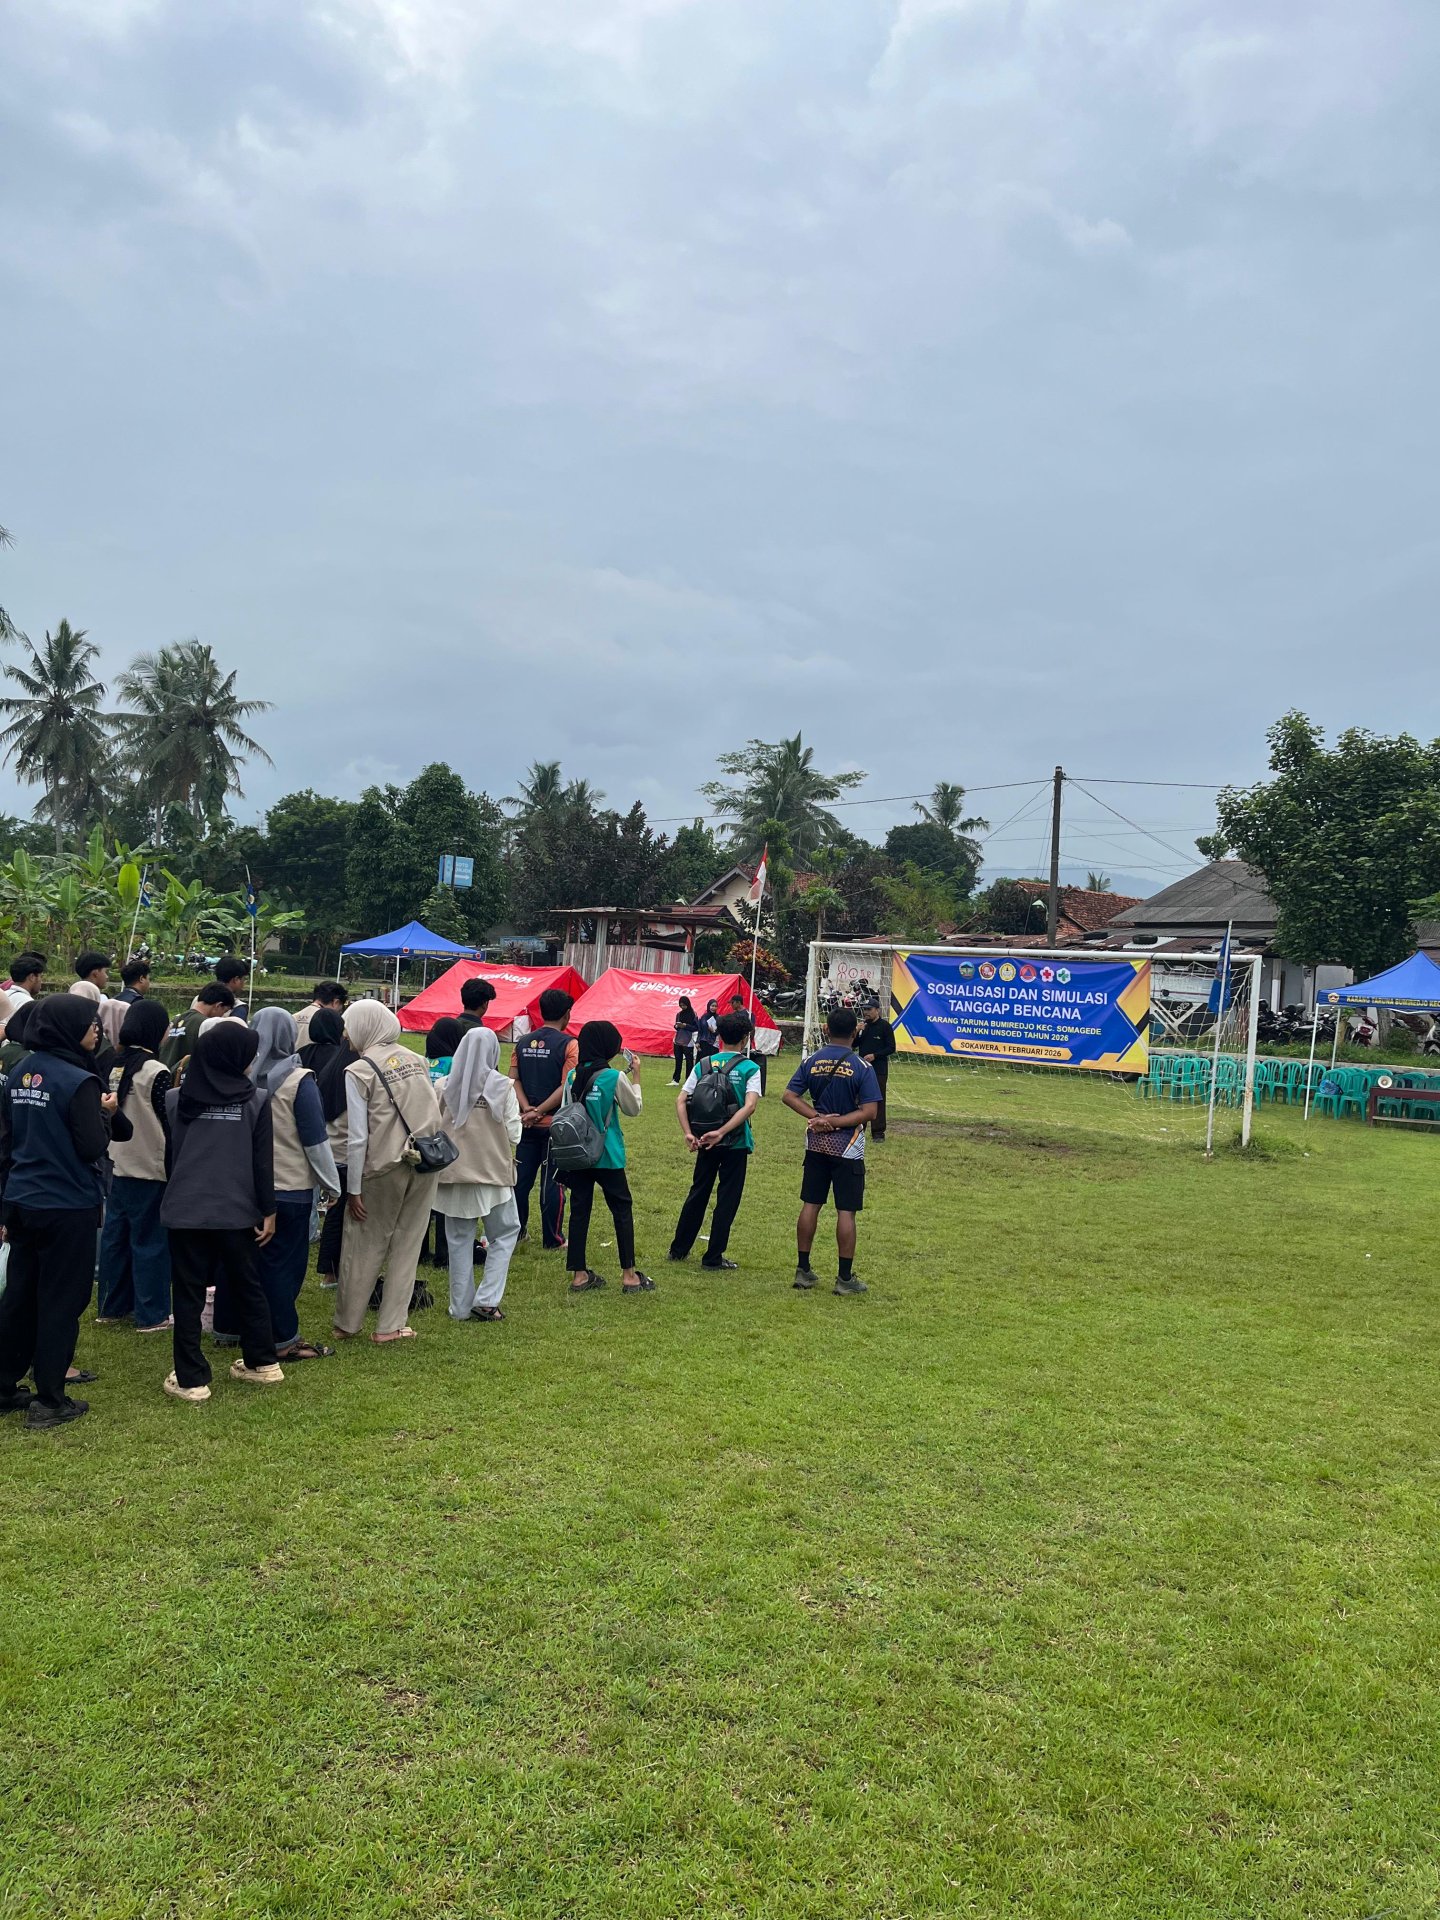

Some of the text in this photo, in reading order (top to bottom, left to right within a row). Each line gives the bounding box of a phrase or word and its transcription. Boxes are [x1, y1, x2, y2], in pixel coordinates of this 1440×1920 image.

[629, 981, 699, 997] KEMENSOS
[927, 983, 1108, 1005] SOSIALISASI DAN SIMULASI
[948, 999, 1082, 1020] TANGGAP BENCANA
[926, 1015, 1102, 1036] KARANG TARUNA BUMIREDJO KEC. SOMAGEDE
[956, 1026, 1069, 1042] DAN KKN UNSOED TAHUN 2026
[960, 1041, 1001, 1053] SOKAWERA,
[1008, 1046, 1043, 1055] FEBRUARI
[1044, 1049, 1062, 1057] 2026
